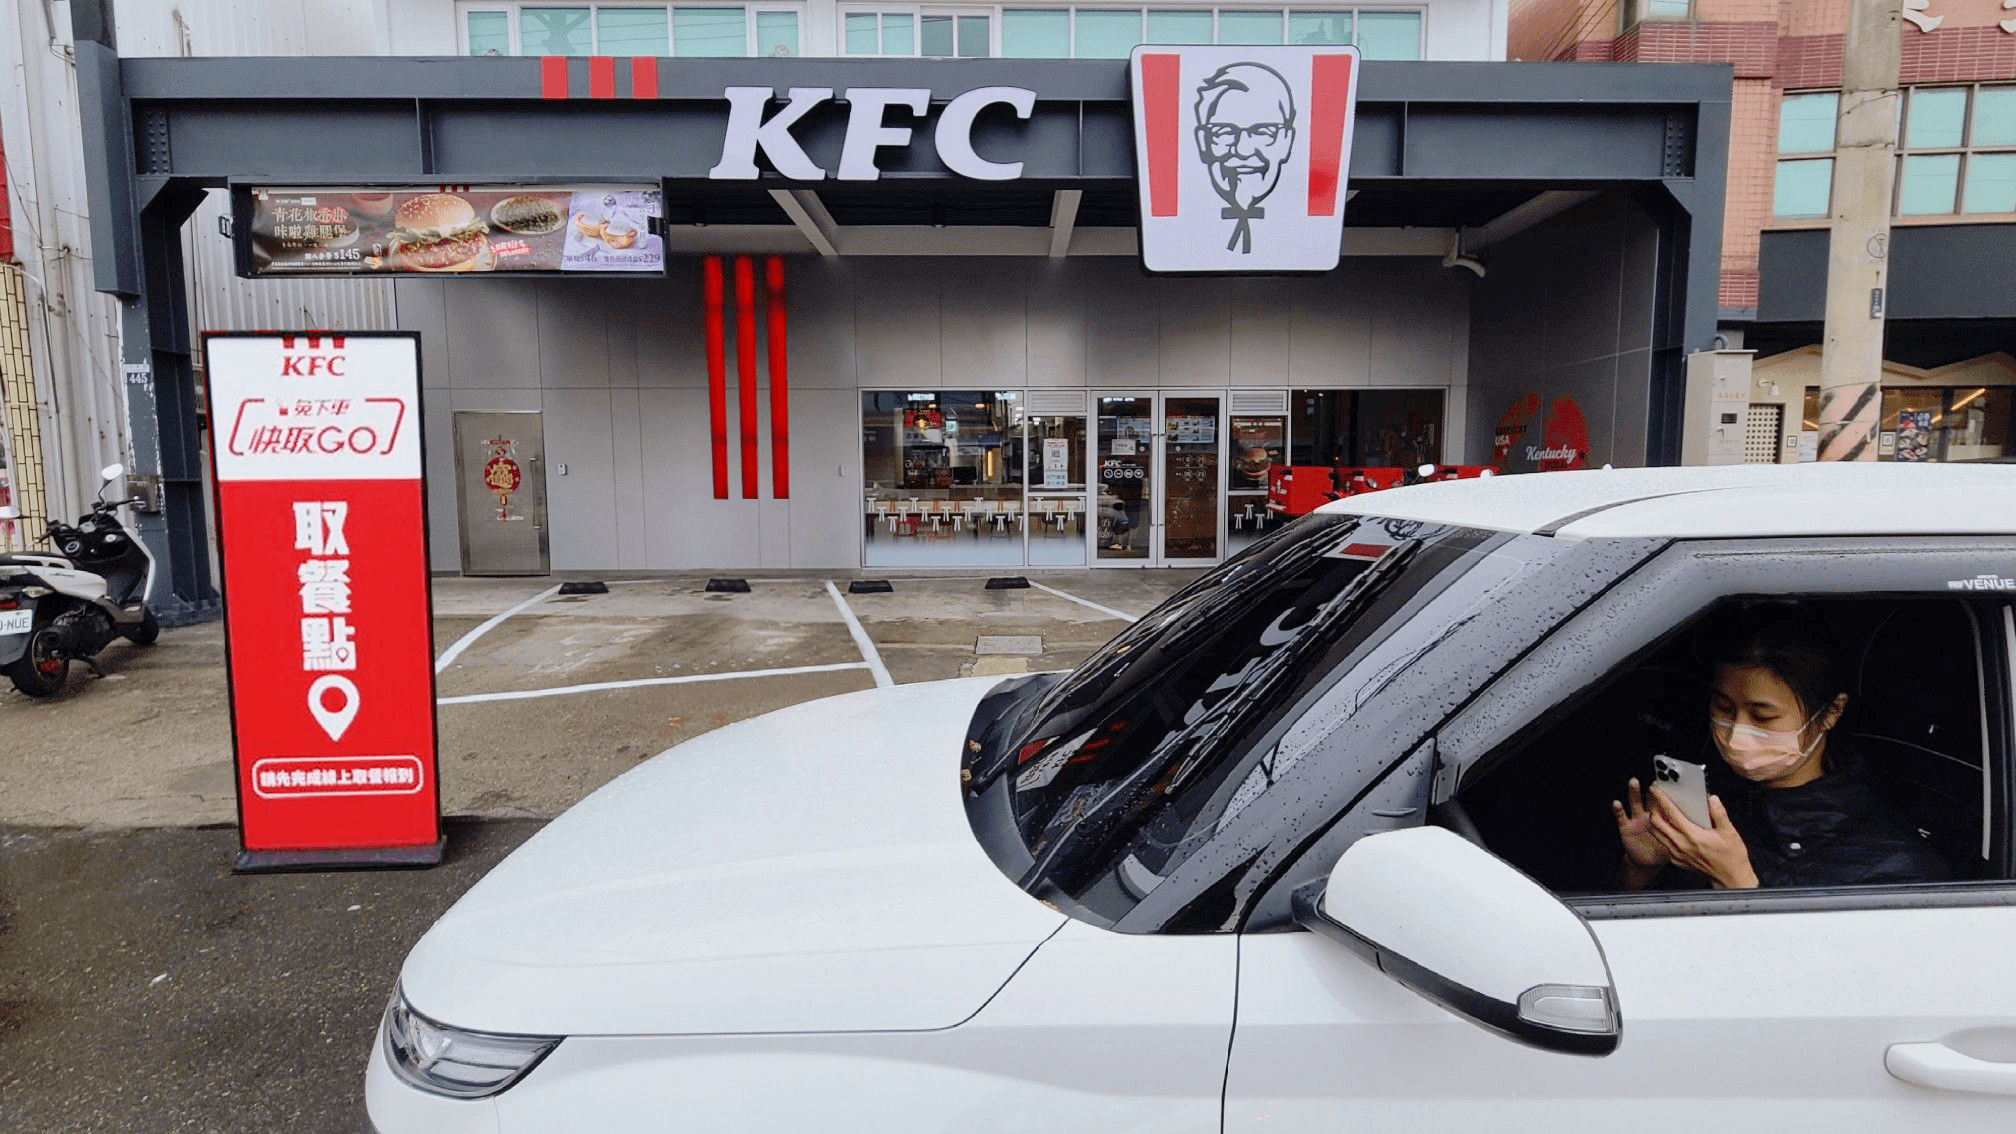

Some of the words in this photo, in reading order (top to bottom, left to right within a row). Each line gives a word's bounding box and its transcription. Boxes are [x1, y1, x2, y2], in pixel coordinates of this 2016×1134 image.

[709, 86, 1037, 181] KFC
[281, 356, 345, 376] KFC
[129, 372, 148, 384] 445
[295, 399, 351, 416] 免下車
[249, 426, 376, 454] 快取GO
[1494, 434, 1510, 446] USA
[1525, 444, 1577, 464] Kentucky
[293, 501, 357, 671] 取餐點
[1962, 578, 2016, 590] VENUE
